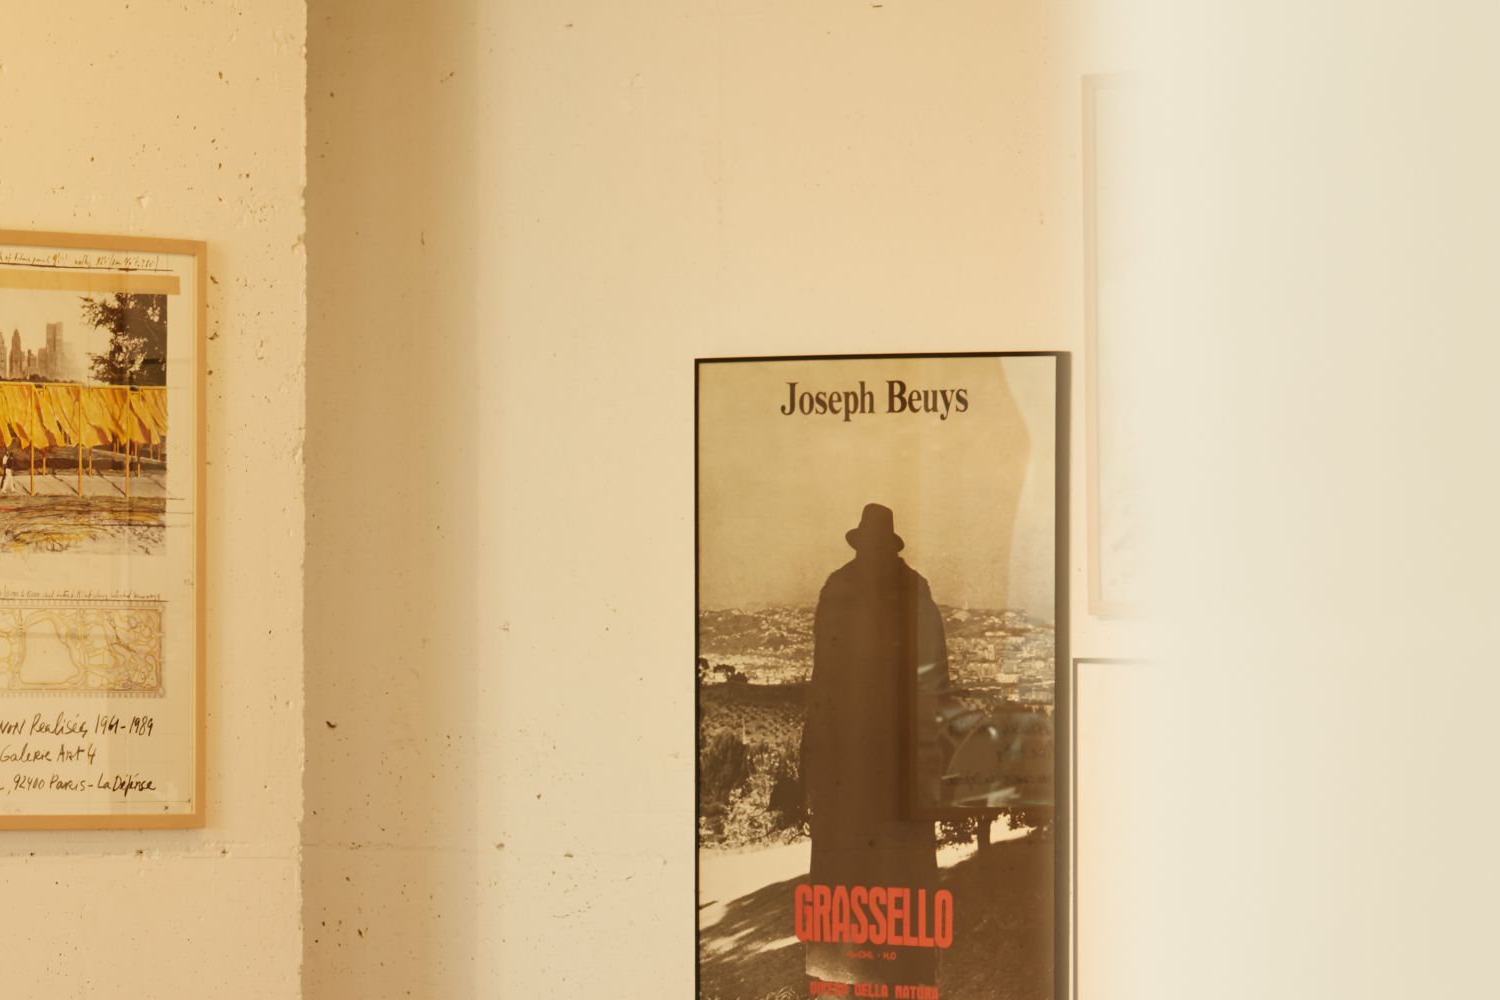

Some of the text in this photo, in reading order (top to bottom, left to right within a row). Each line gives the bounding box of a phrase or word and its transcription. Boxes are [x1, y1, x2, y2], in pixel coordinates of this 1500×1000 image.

[780, 380, 968, 422] Joseph Beuys
[0, 743, 52, 762] Galerie
[794, 884, 954, 948] GRASSELLO
[854, 983, 888, 998] DELLA
[895, 984, 939, 1000] NATURA
